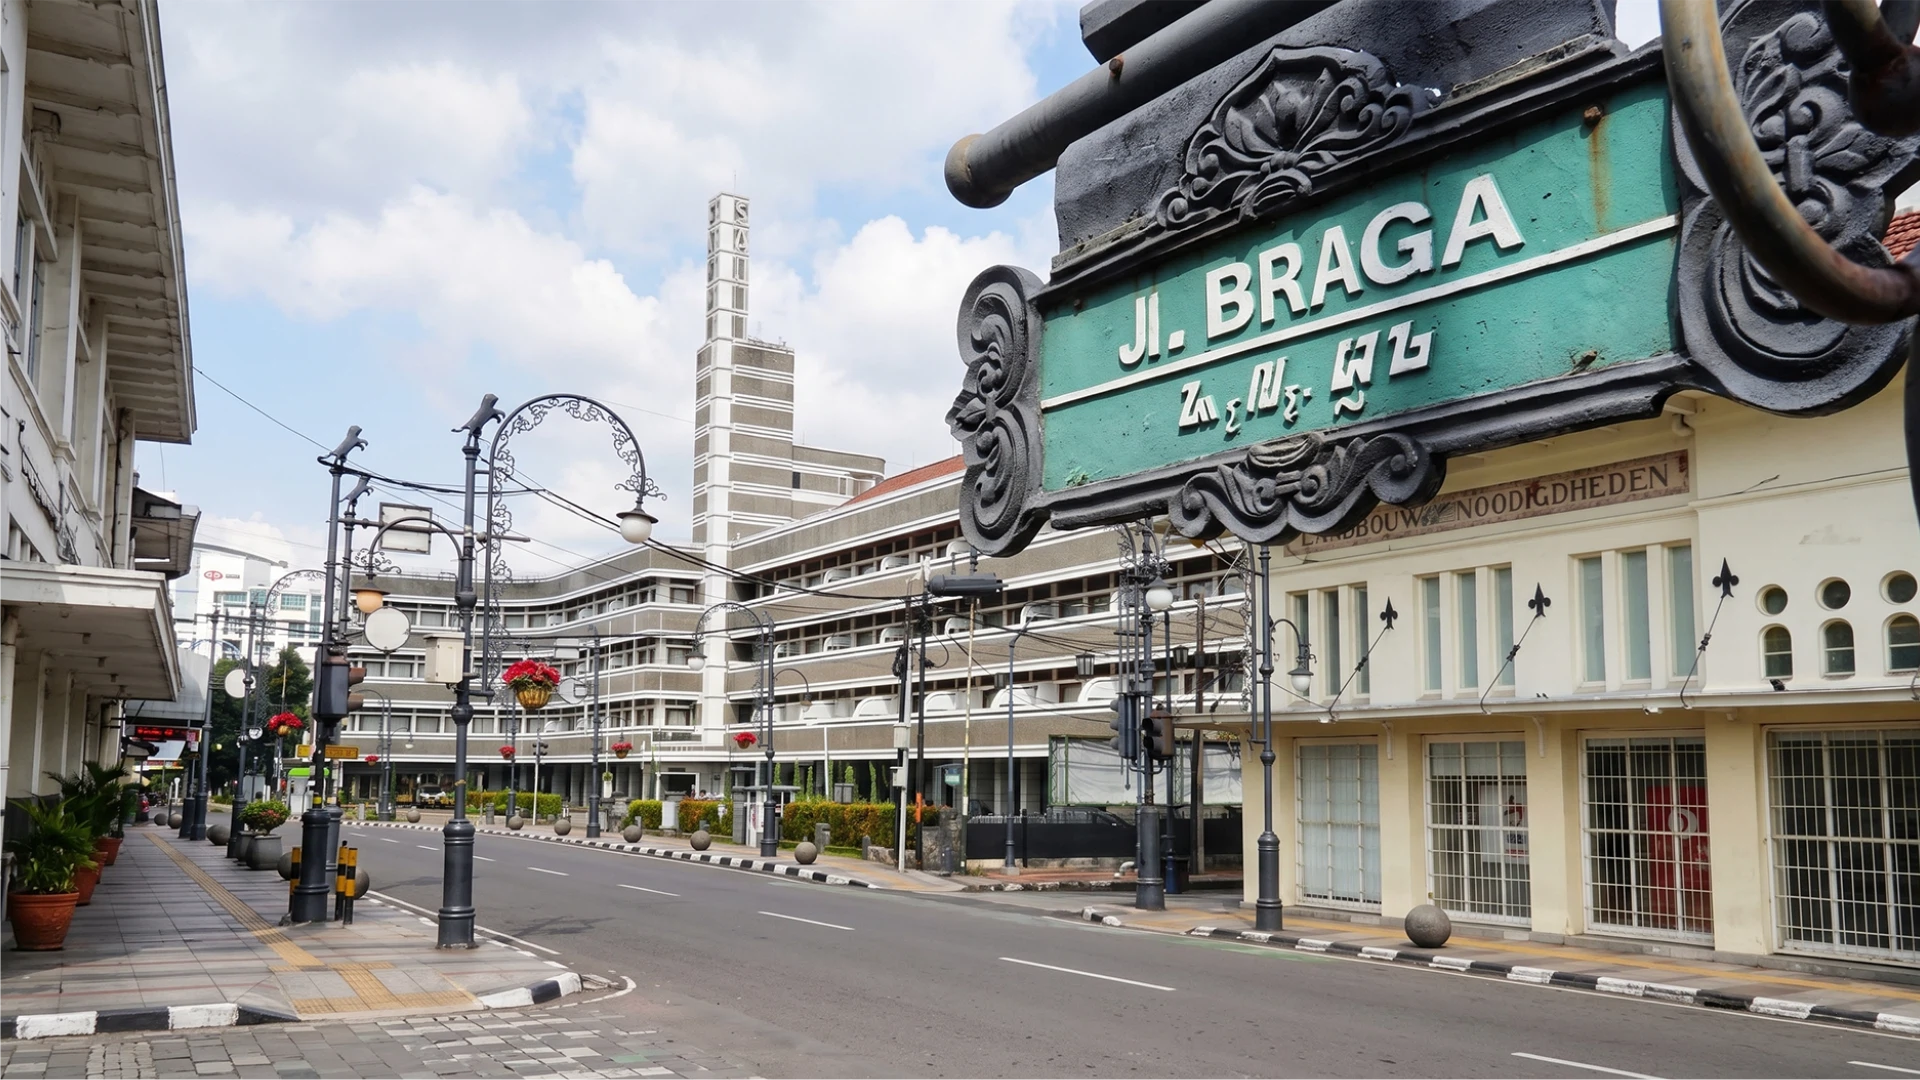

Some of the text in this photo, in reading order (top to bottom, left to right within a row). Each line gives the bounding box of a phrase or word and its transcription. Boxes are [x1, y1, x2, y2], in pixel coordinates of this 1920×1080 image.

[1119, 173, 1525, 364] Jl. BRAGA
[1456, 463, 1669, 521] NOODIGDHEDEN
